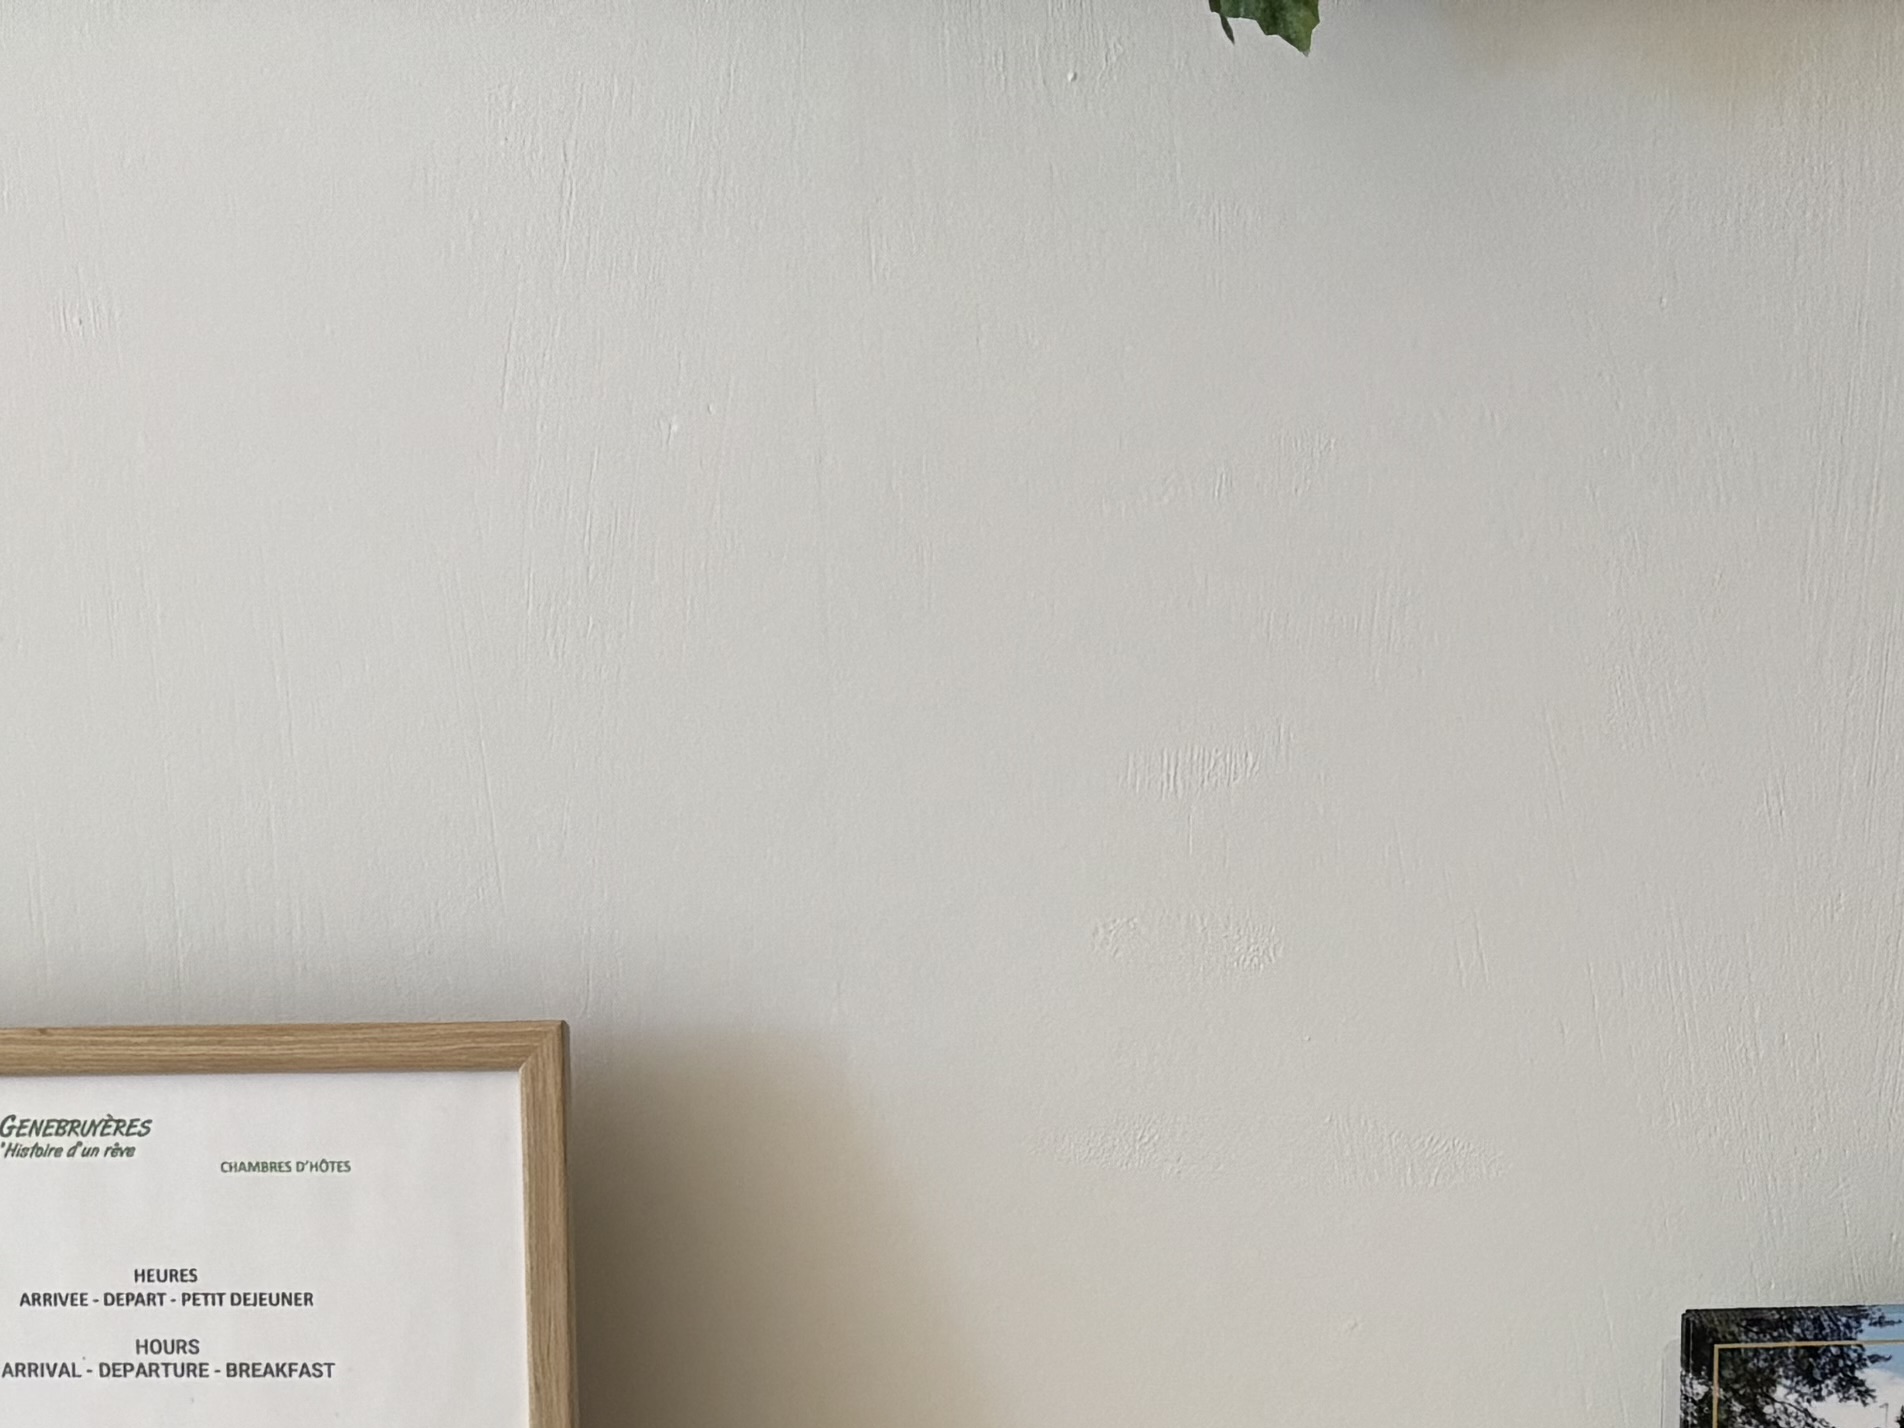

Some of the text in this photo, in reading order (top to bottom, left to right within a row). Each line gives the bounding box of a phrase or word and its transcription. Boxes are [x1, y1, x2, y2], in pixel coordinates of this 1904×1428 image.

[220, 1158, 351, 1173] CHAMBRES D'HÔTES
[134, 1267, 197, 1282] HEURES
[19, 1292, 88, 1306] ARRIVEE
[103, 1292, 166, 1306] DEPART
[181, 1292, 225, 1306] PETIT
[230, 1291, 313, 1306] DEJEUNER
[135, 1338, 199, 1354] HOURS
[1, 1362, 81, 1377] ARRIVAL
[98, 1361, 209, 1378] DEPARTURE
[225, 1362, 335, 1378] BREAKFAST
